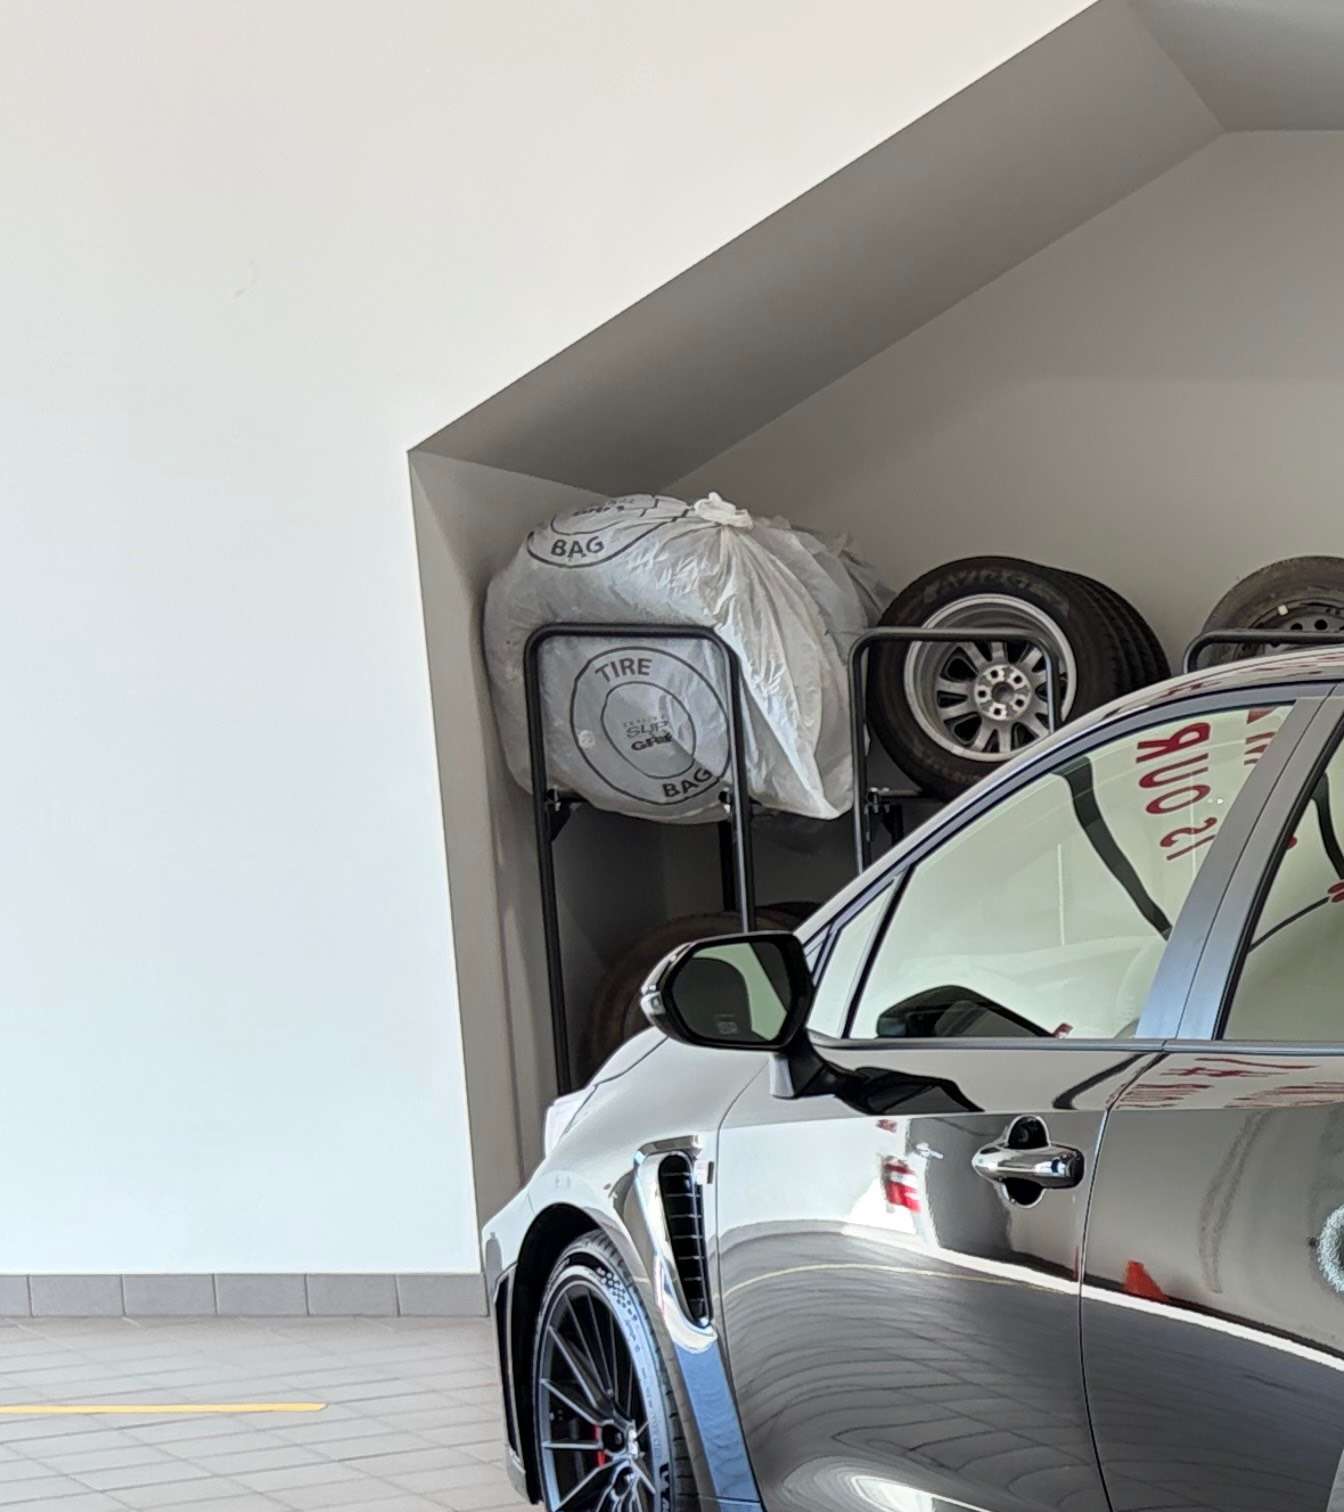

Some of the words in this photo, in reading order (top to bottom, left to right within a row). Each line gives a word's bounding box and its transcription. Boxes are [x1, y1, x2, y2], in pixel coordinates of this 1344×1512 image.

[551, 536, 604, 558] BAG
[595, 658, 652, 682] TIRE
[662, 767, 713, 798] BAG
